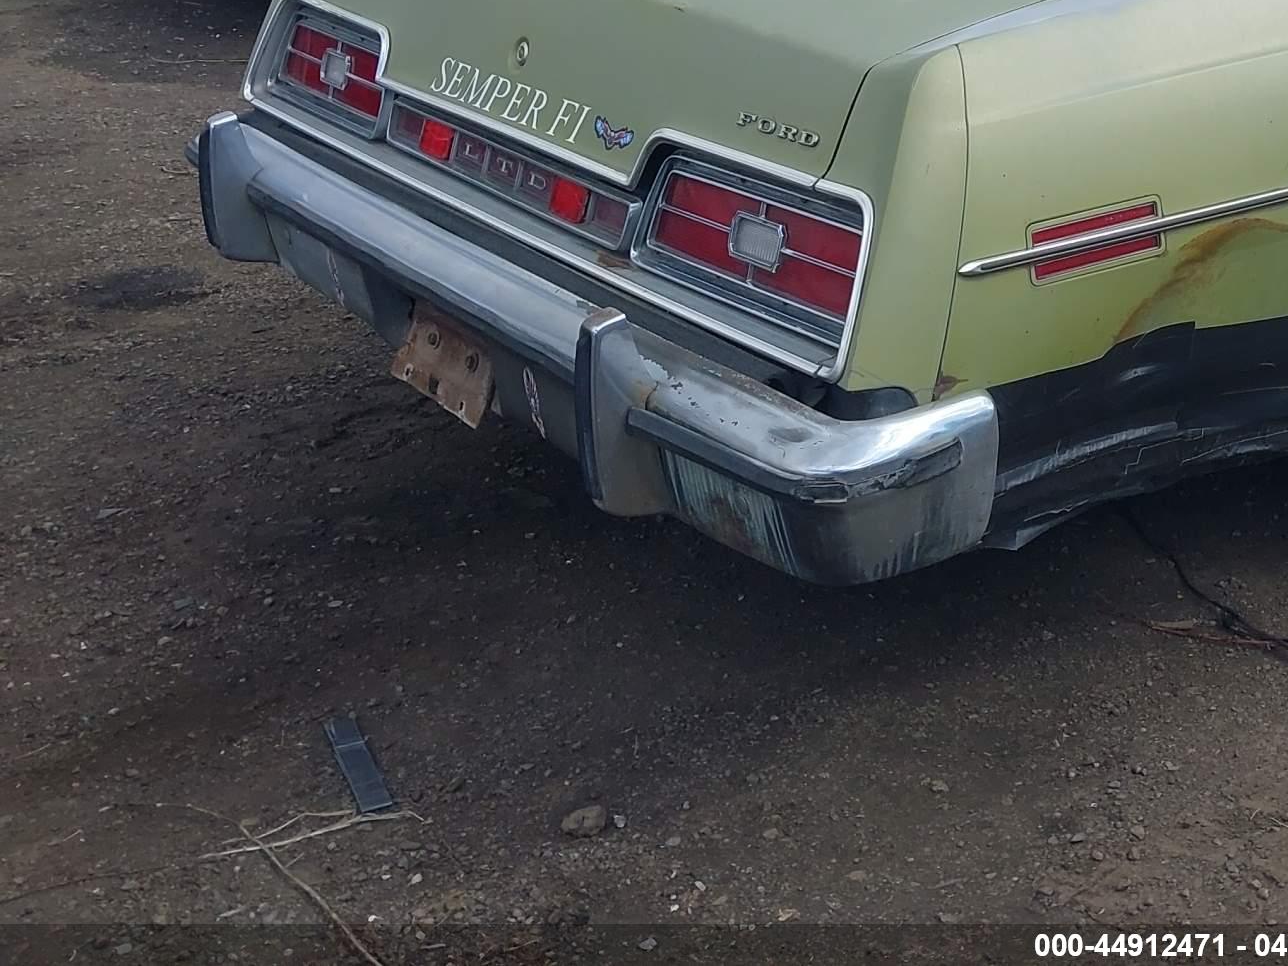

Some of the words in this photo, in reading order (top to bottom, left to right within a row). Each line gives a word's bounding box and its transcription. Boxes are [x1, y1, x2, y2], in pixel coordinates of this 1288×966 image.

[431, 57, 548, 130] SEMPER
[546, 98, 592, 144] FI
[736, 111, 820, 148] FORD
